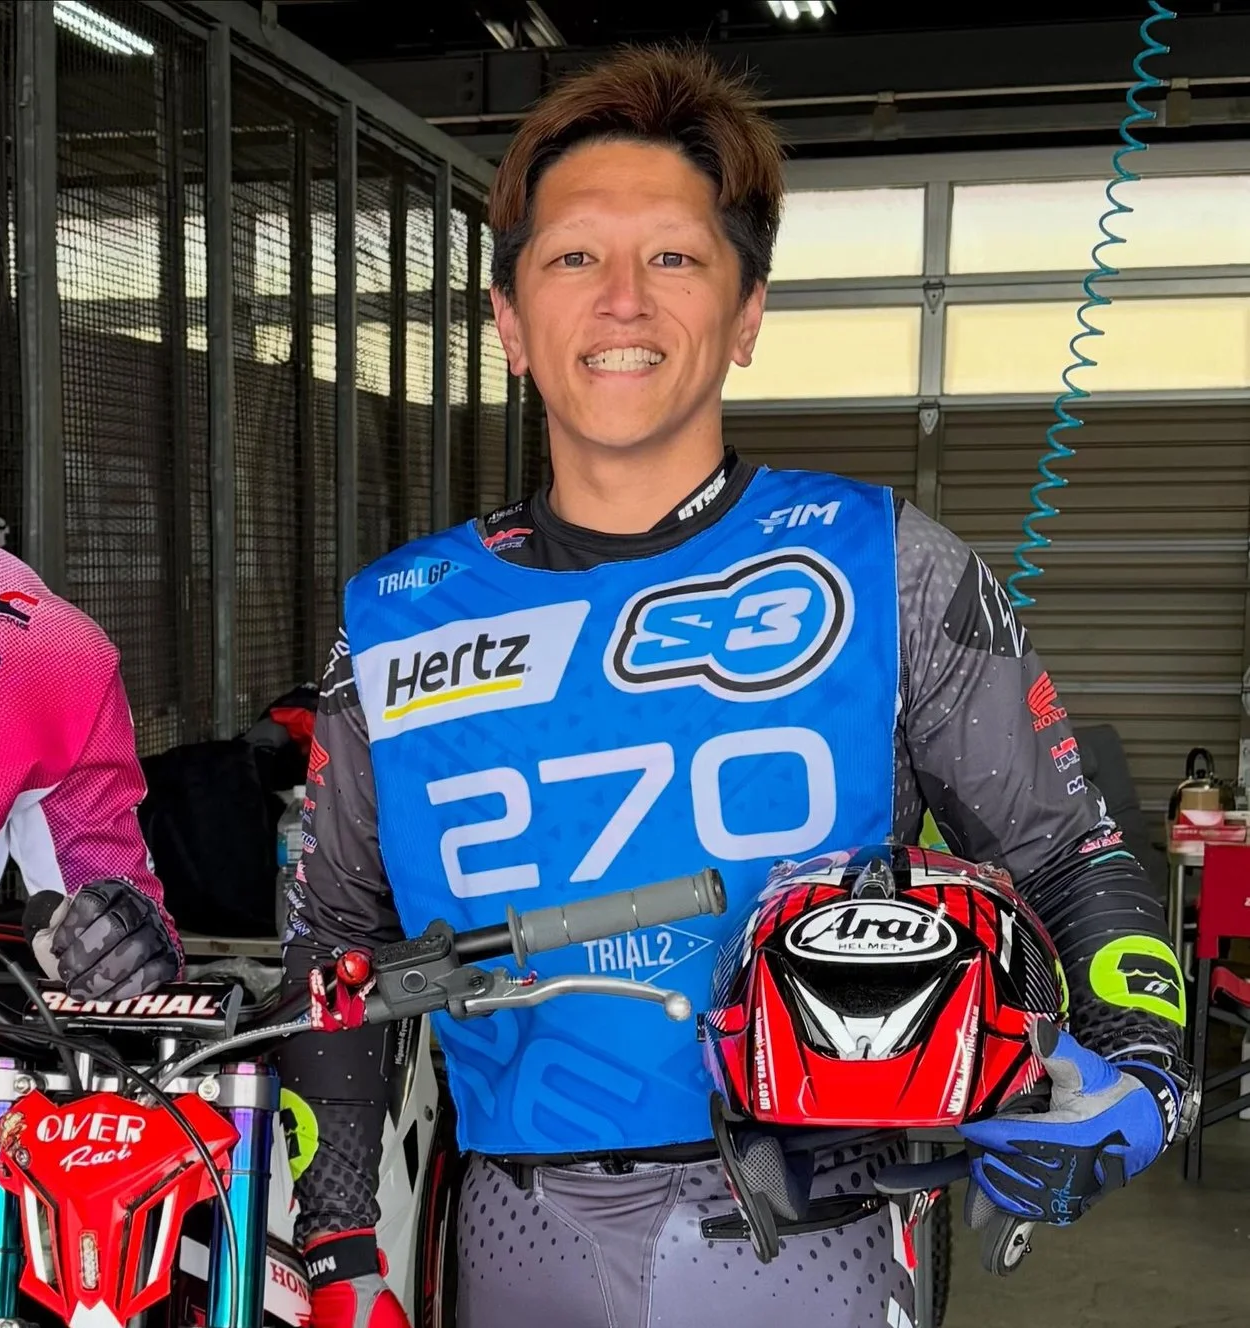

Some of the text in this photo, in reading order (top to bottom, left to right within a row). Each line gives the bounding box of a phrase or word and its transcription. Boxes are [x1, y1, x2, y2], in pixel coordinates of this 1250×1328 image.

[757, 501, 841, 534] FIM
[386, 632, 531, 707] Hertz
[426, 726, 837, 899] 270
[797, 907, 934, 947] Arai
[582, 933, 674, 975] TRIAL2
[36, 1112, 146, 1144] OVER
[270, 1262, 311, 1302] HON
